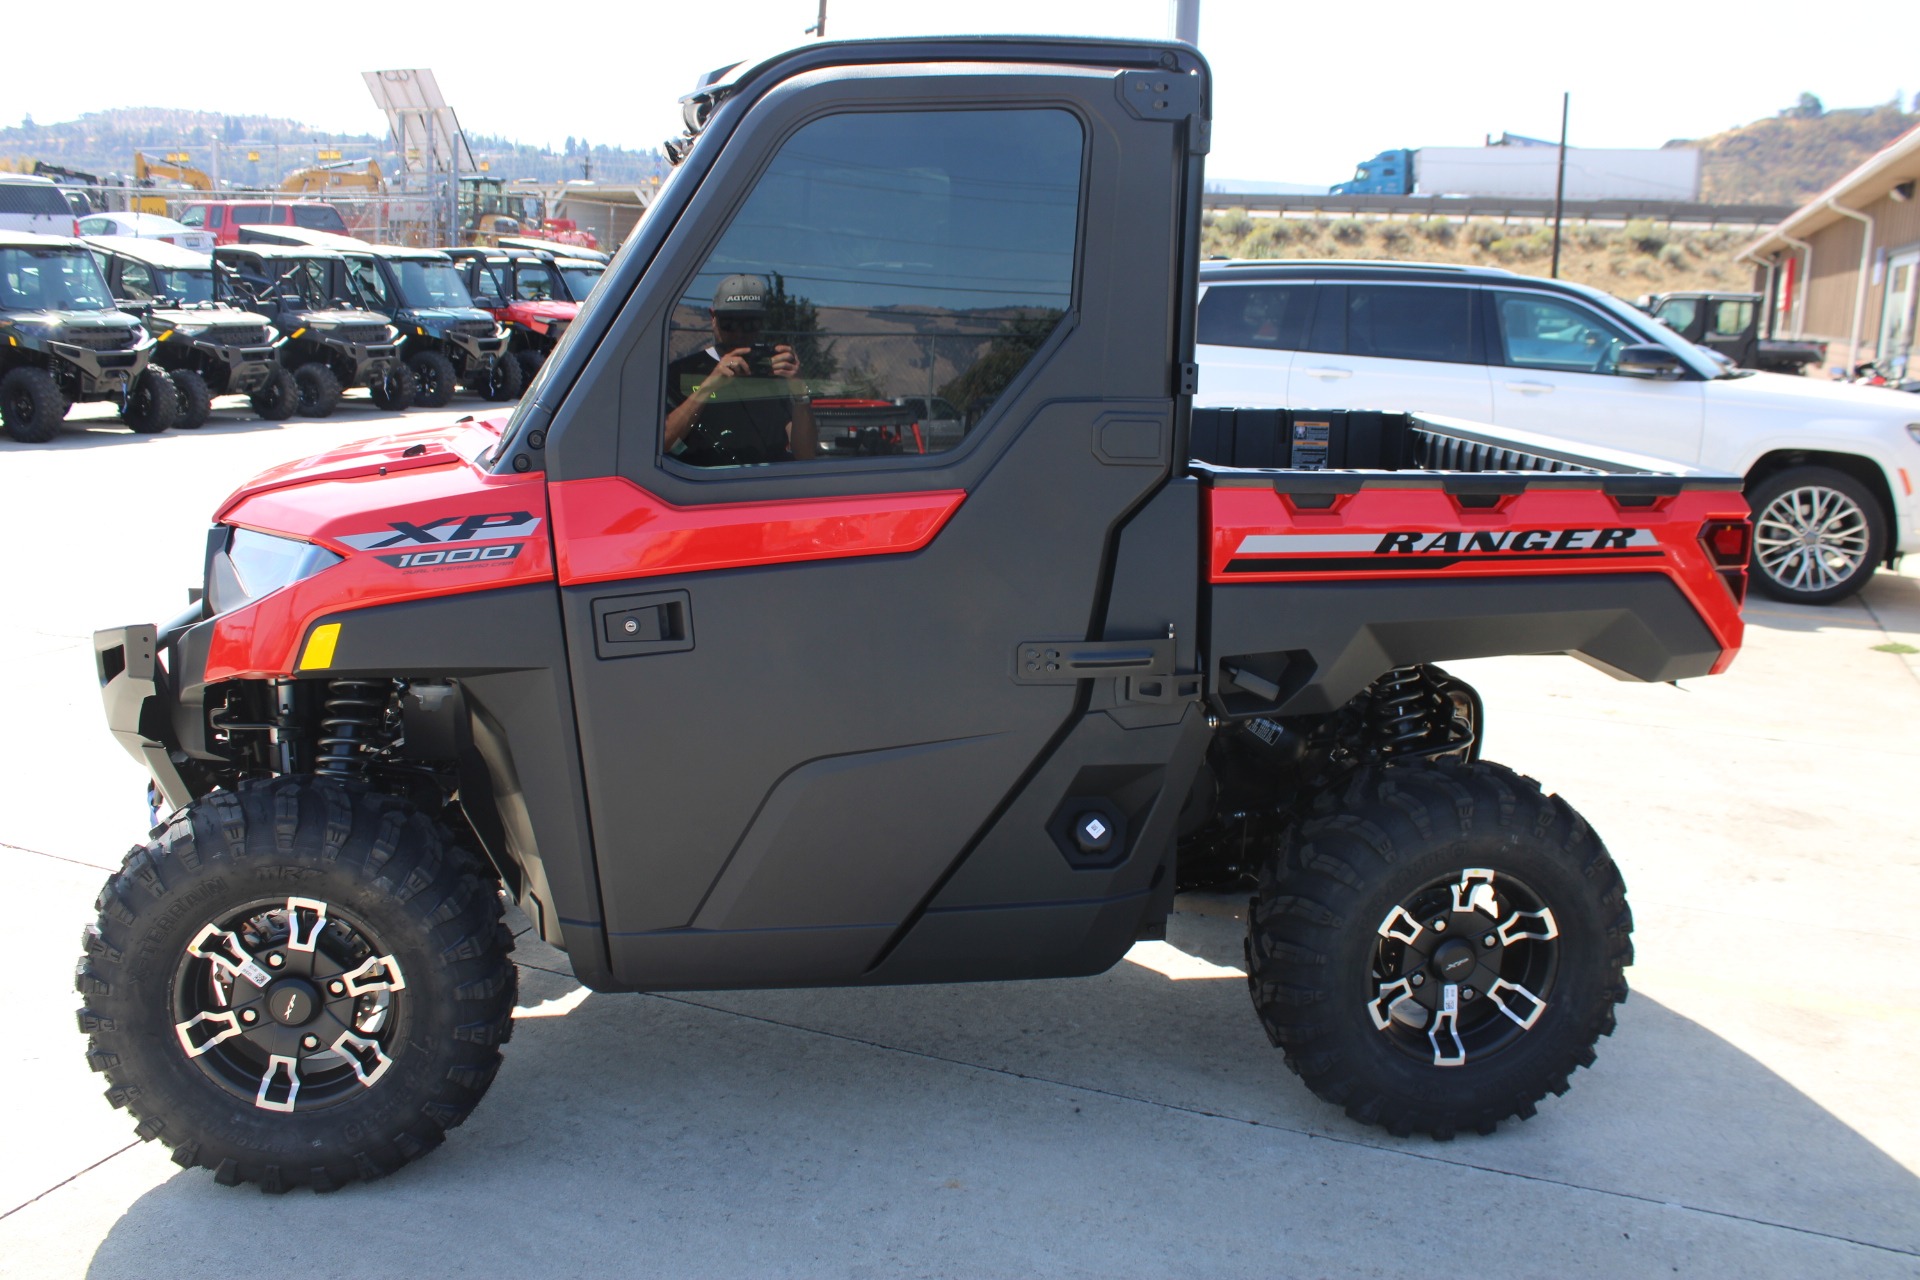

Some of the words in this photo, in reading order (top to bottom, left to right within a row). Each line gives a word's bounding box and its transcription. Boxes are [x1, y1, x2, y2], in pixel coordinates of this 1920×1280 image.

[365, 511, 534, 549] XP
[1374, 527, 1636, 554] RANGER
[398, 545, 515, 568] 1000
[432, 563, 489, 573] OVERHEAD
